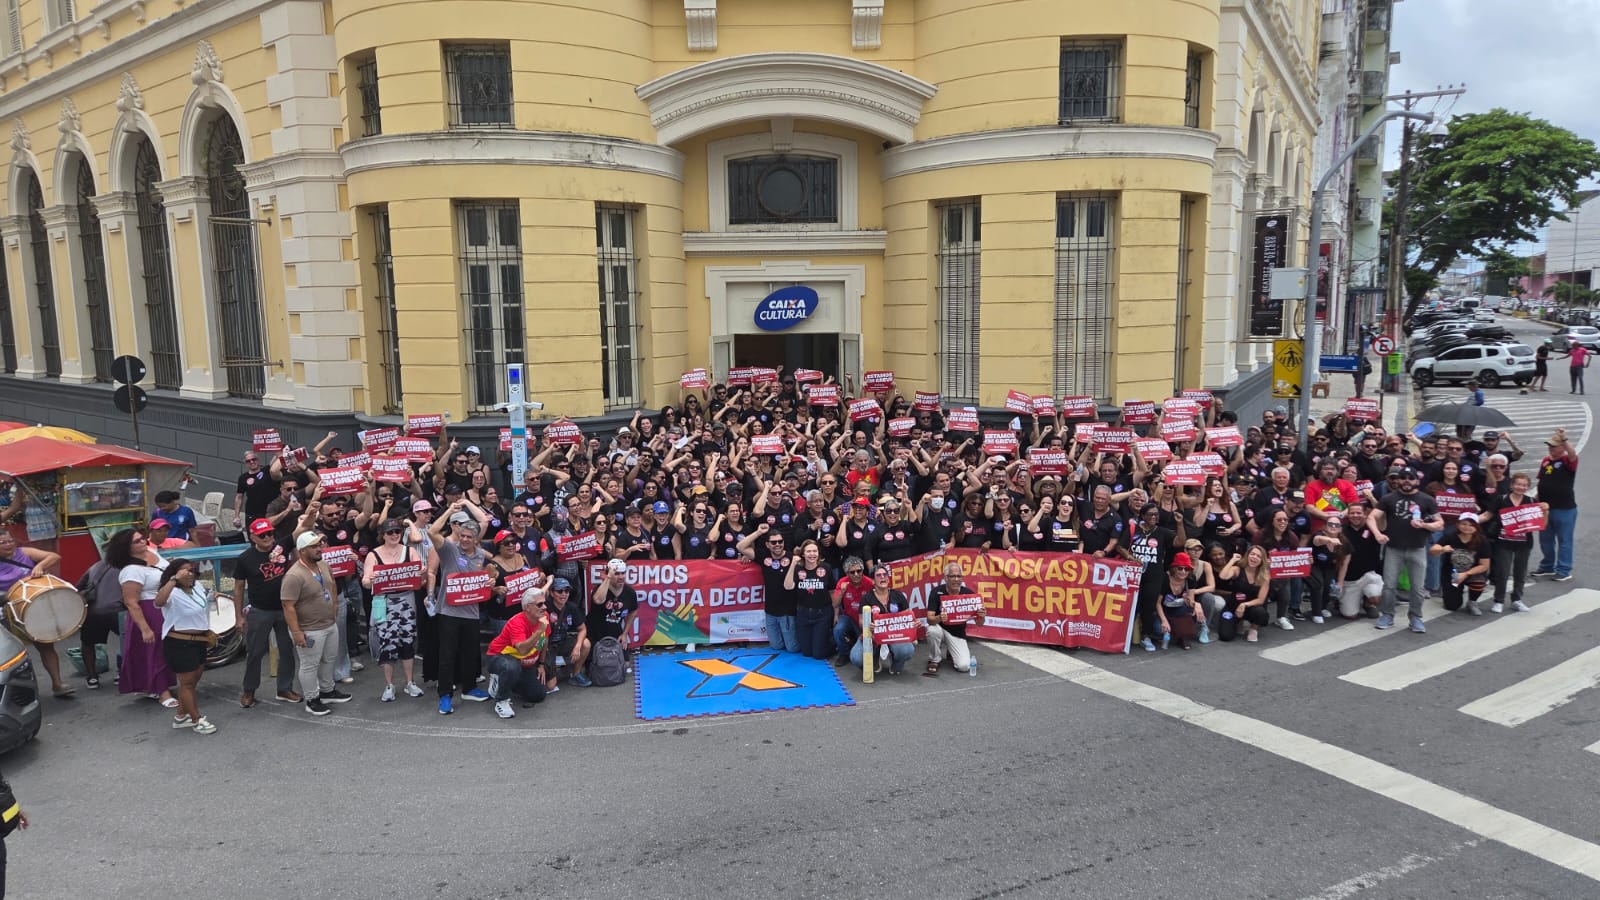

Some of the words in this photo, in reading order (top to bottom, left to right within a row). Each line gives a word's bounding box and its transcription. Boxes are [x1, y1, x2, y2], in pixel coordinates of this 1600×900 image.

[769, 299, 806, 309] CAIXA
[759, 309, 807, 320] CULTURAL
[409, 416, 441, 424] ESTAMOS
[1162, 419, 1193, 428] ESTAMOS
[367, 430, 398, 440] ESTAMOS
[338, 452, 370, 464] ESTAMOS
[1030, 452, 1067, 461] ESTAMOS
[320, 468, 361, 480] ESTAMOS
[335, 474, 363, 485] GREVE
[321, 548, 352, 560] TAMOS
[1131, 545, 1158, 555] CAIXA
[1271, 553, 1310, 562] ESTAMOS
[1284, 560, 1311, 568] GREVE
[374, 564, 420, 576] ESTAMOS
[591, 565, 689, 585] EGIMOS
[390, 571, 422, 581] GREVE
[447, 574, 489, 585] ESTAMOS
[506, 571, 539, 588] ESTAMOS
[1092, 562, 1129, 590] DA
[447, 585, 461, 593] EM
[798, 581, 825, 590] CORAGEM
[942, 597, 982, 607] ESTAMOS
[977, 581, 1020, 611] EM
[1025, 586, 1128, 623] GREVE
[956, 603, 984, 613] GREVE
[874, 615, 913, 626] ESTAMOS
[874, 626, 887, 634] EM
[888, 621, 916, 632] GREVE
